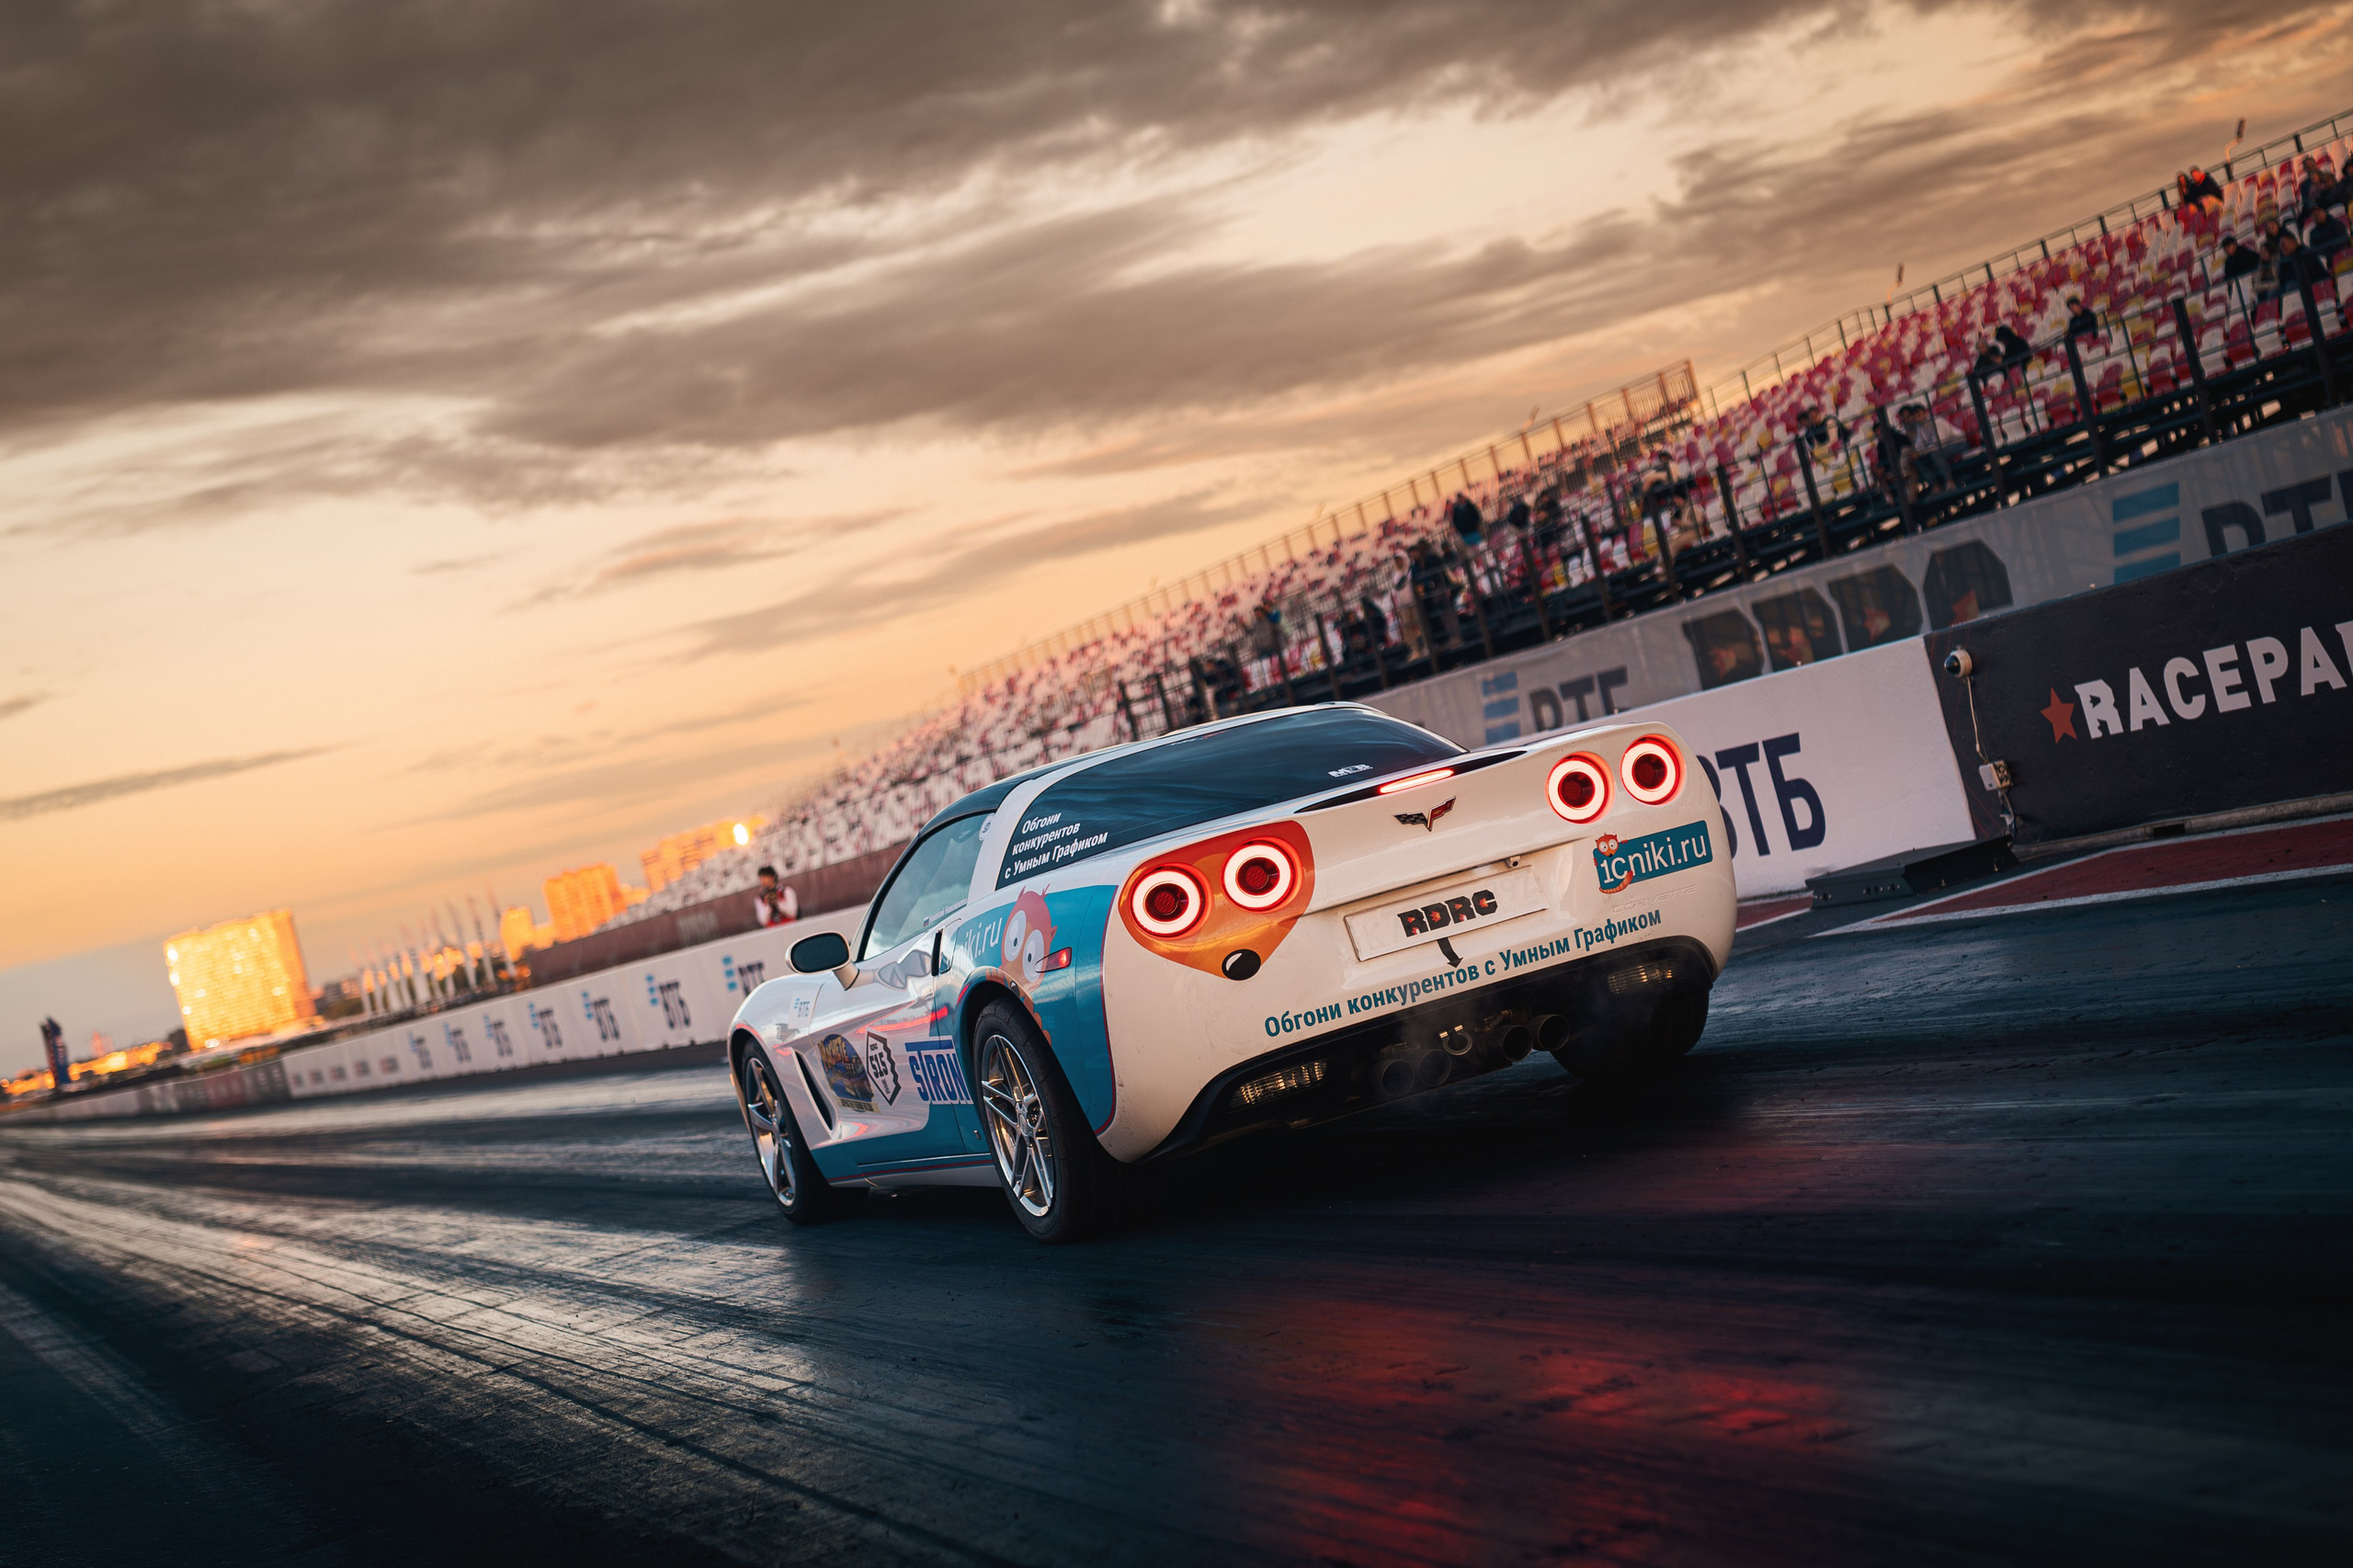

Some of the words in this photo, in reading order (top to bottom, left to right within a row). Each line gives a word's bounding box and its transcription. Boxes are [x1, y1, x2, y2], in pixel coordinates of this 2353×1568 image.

[1011, 823, 1081, 856] конкурентов
[1021, 812, 1062, 835] Обгони
[1004, 867, 1011, 880] с
[1013, 852, 1051, 876] Умным
[1051, 832, 1108, 862] Графиком
[1396, 889, 1498, 937] RDRC
[1264, 1002, 1343, 1038] Обгони
[1347, 964, 1480, 1015] конкурентов
[1484, 959, 1496, 976] с
[1499, 937, 1571, 971] Умным
[1574, 909, 1662, 951] Графиком
[870, 1051, 889, 1078] 515
